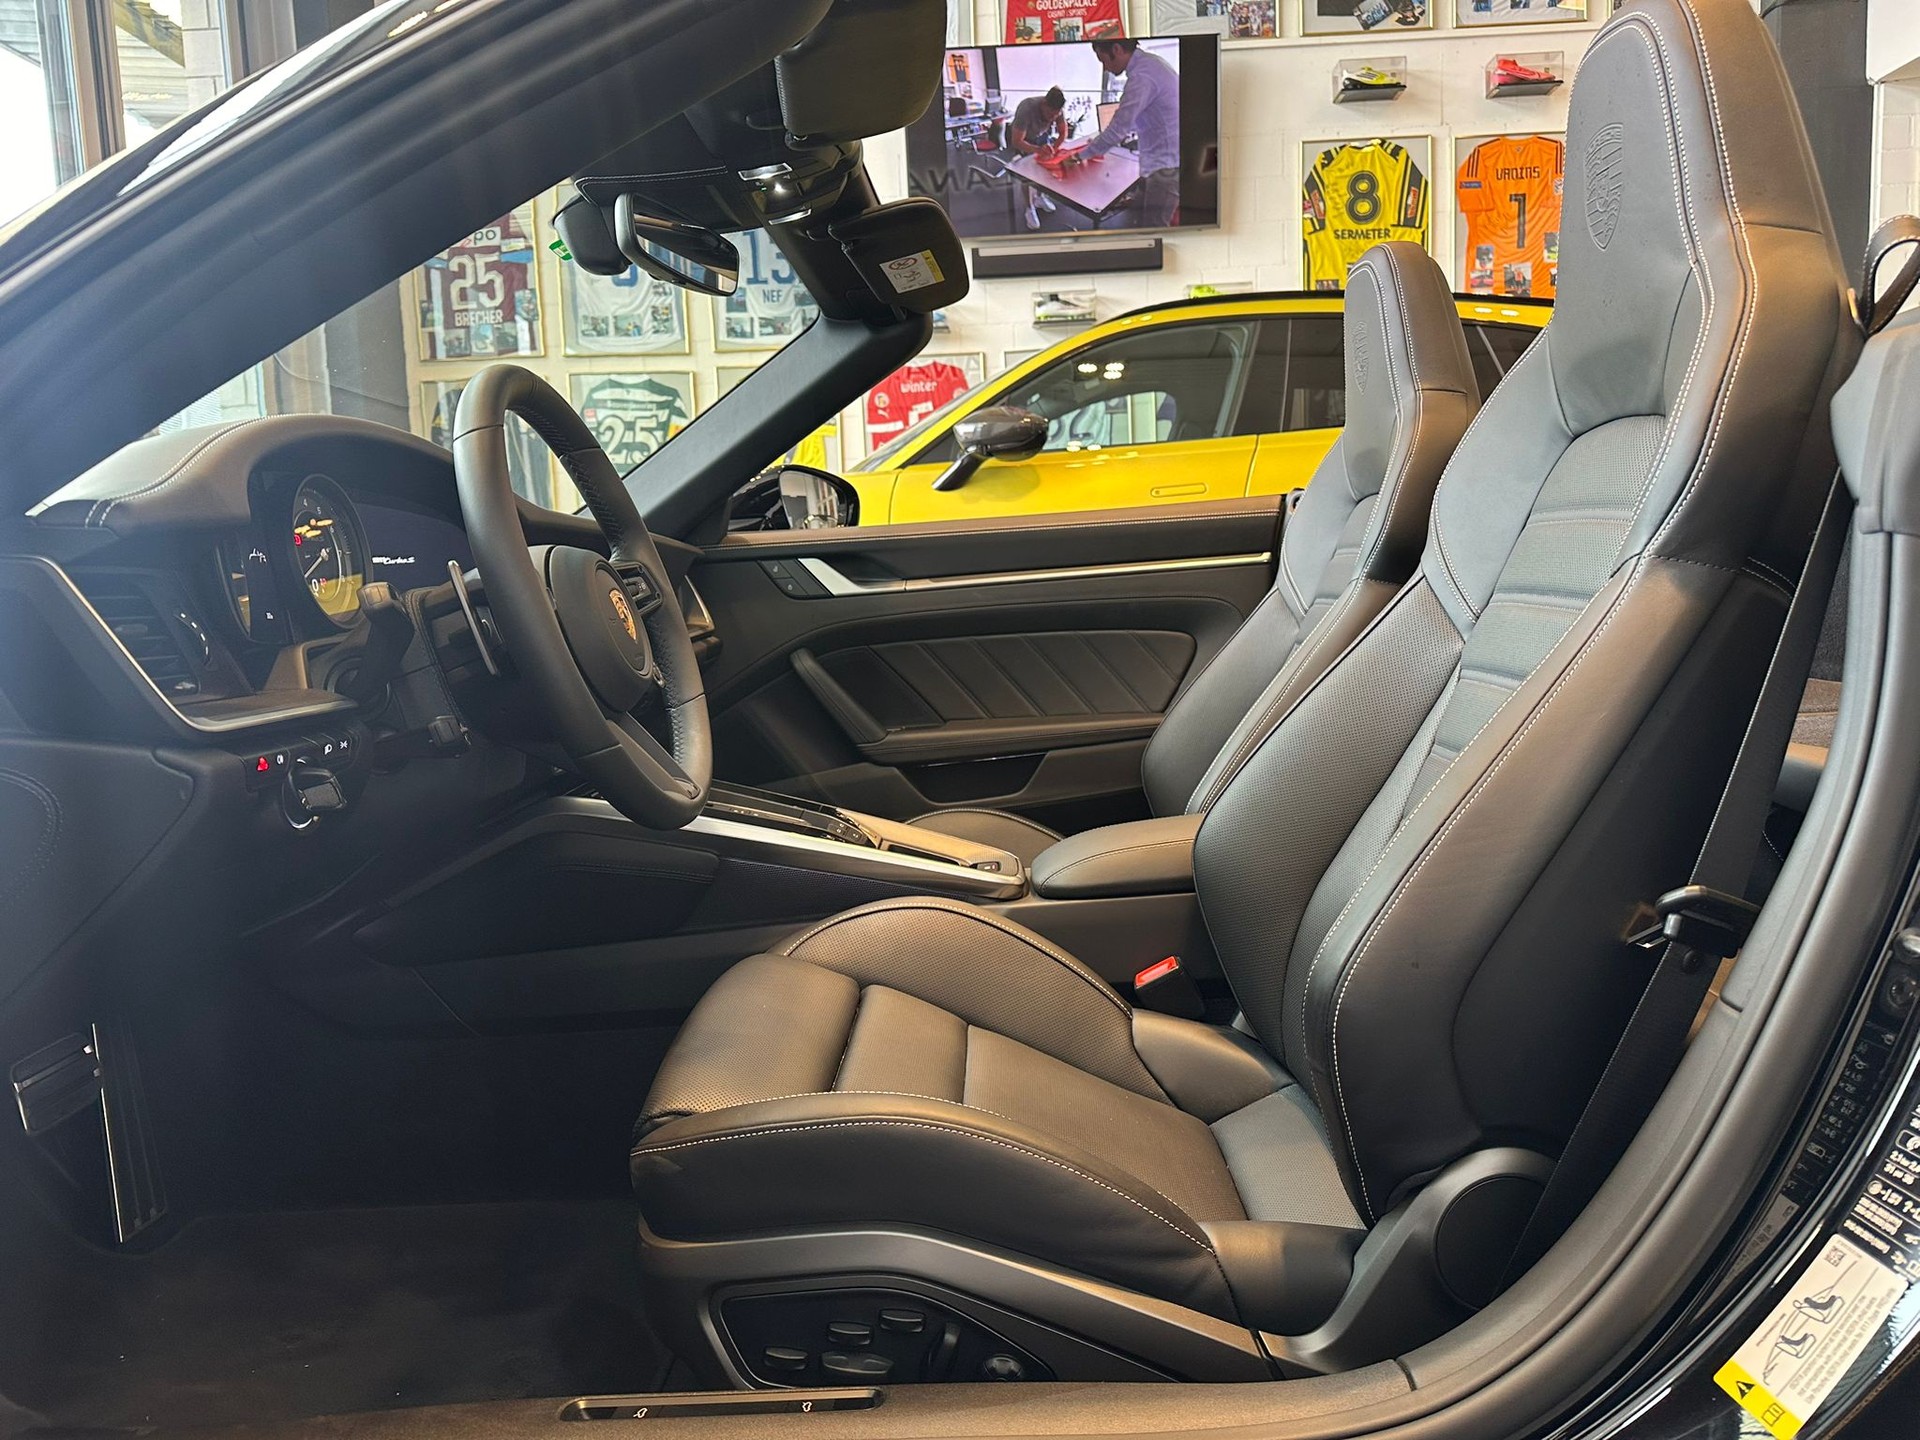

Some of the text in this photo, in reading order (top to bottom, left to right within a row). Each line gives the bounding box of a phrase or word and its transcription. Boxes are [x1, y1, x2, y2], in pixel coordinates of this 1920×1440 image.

[1346, 170, 1382, 224] 8
[1509, 193, 1526, 249] 1
[1333, 228, 1391, 240] SERMETER
[448, 252, 505, 311] 25
[762, 289, 783, 304] NEF
[454, 309, 503, 327] BRECHER
[599, 414, 660, 464] 25
